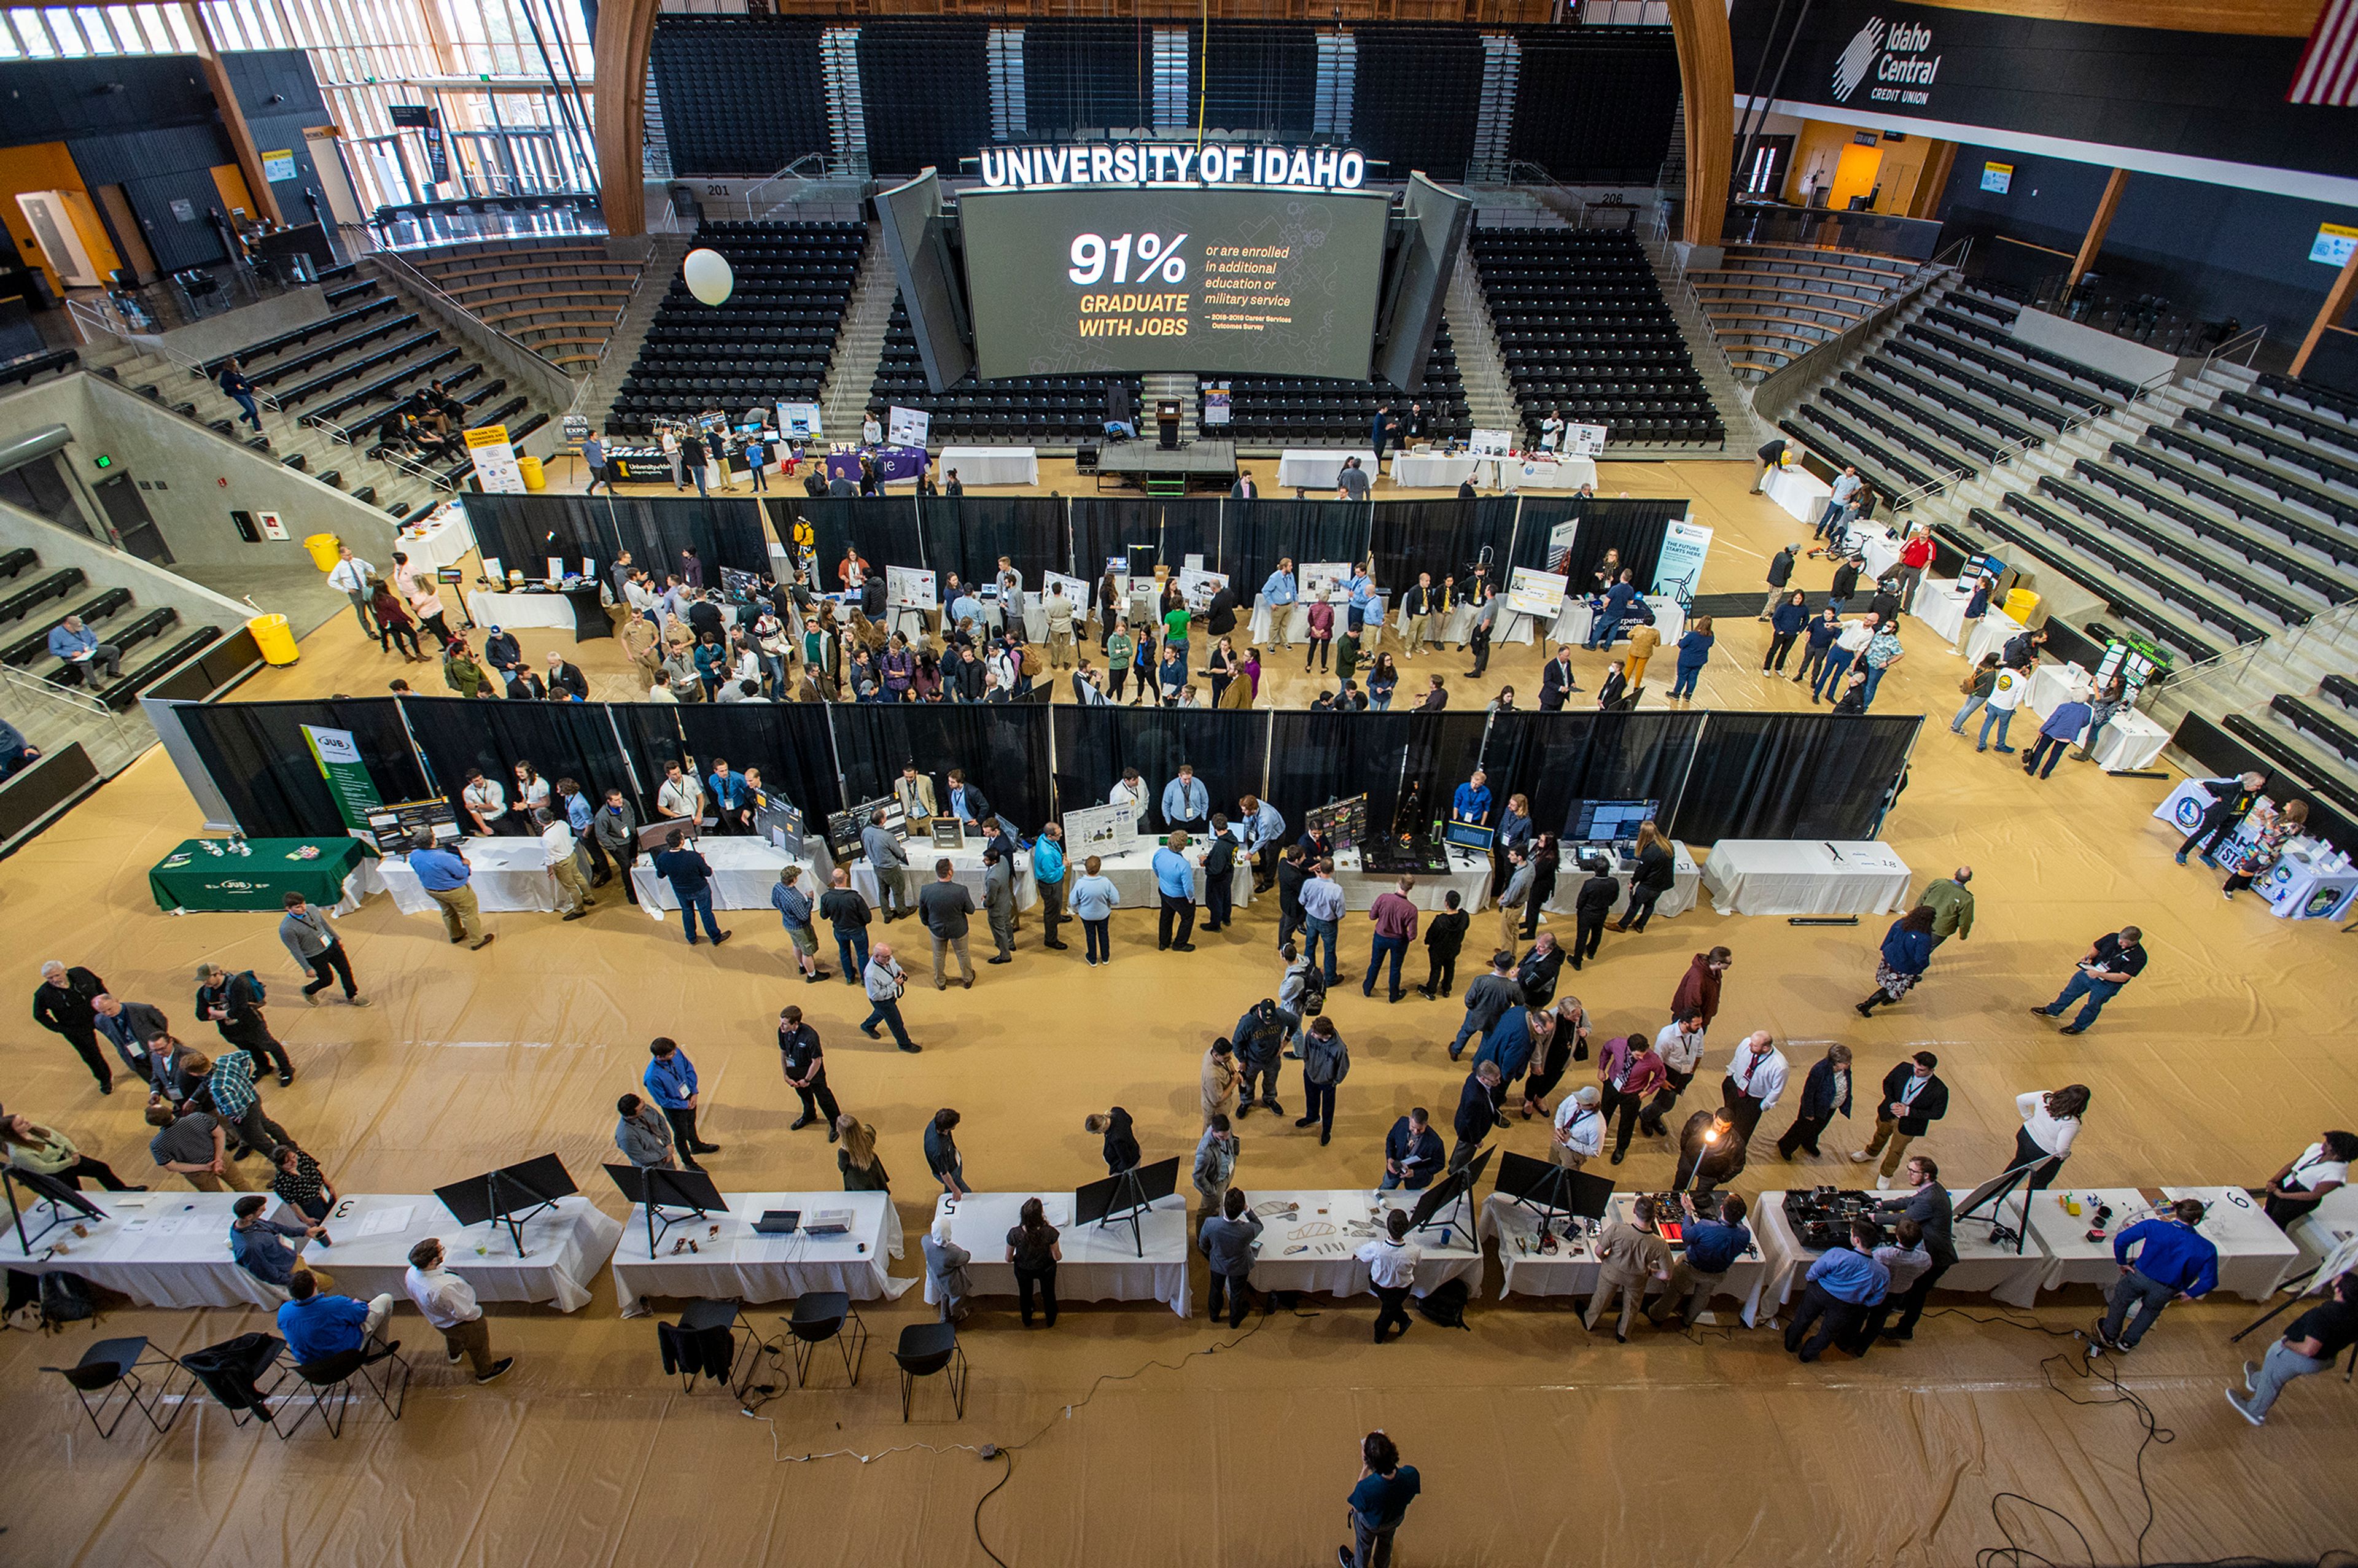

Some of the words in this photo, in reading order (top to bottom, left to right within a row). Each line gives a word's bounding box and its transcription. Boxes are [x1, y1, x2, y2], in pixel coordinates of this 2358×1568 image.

[1885, 22, 1932, 52] Idaho
[1878, 53, 1942, 85] Central
[1871, 87, 1901, 102] CREDIT
[1902, 90, 1929, 105] UNION
[982, 148, 1197, 186] UNIVERSITY
[1199, 147, 1247, 182] OF
[1253, 149, 1364, 188] IDAHO
[708, 185, 730, 196] 201
[1603, 193, 1623, 204] 206
[1069, 232, 1189, 285] 91%
[1206, 247, 1219, 255] or
[1220, 247, 1239, 256] are
[1242, 246, 1290, 258] enrolled
[1205, 260, 1216, 272] in
[1218, 260, 1277, 274] additional
[1205, 277, 1261, 290] education
[1264, 281, 1277, 290] or
[1081, 293, 1189, 313] GRADUATE
[1205, 293, 1248, 307] military
[1250, 295, 1291, 306] service
[1079, 318, 1132, 337] WITH
[1135, 317, 1188, 336] JOBS
[830, 442, 856, 452] SWE
[1666, 546, 1686, 554] STARTS
[1679, 543, 1700, 552] FUTURE
[1881, 860, 1897, 868] 18
